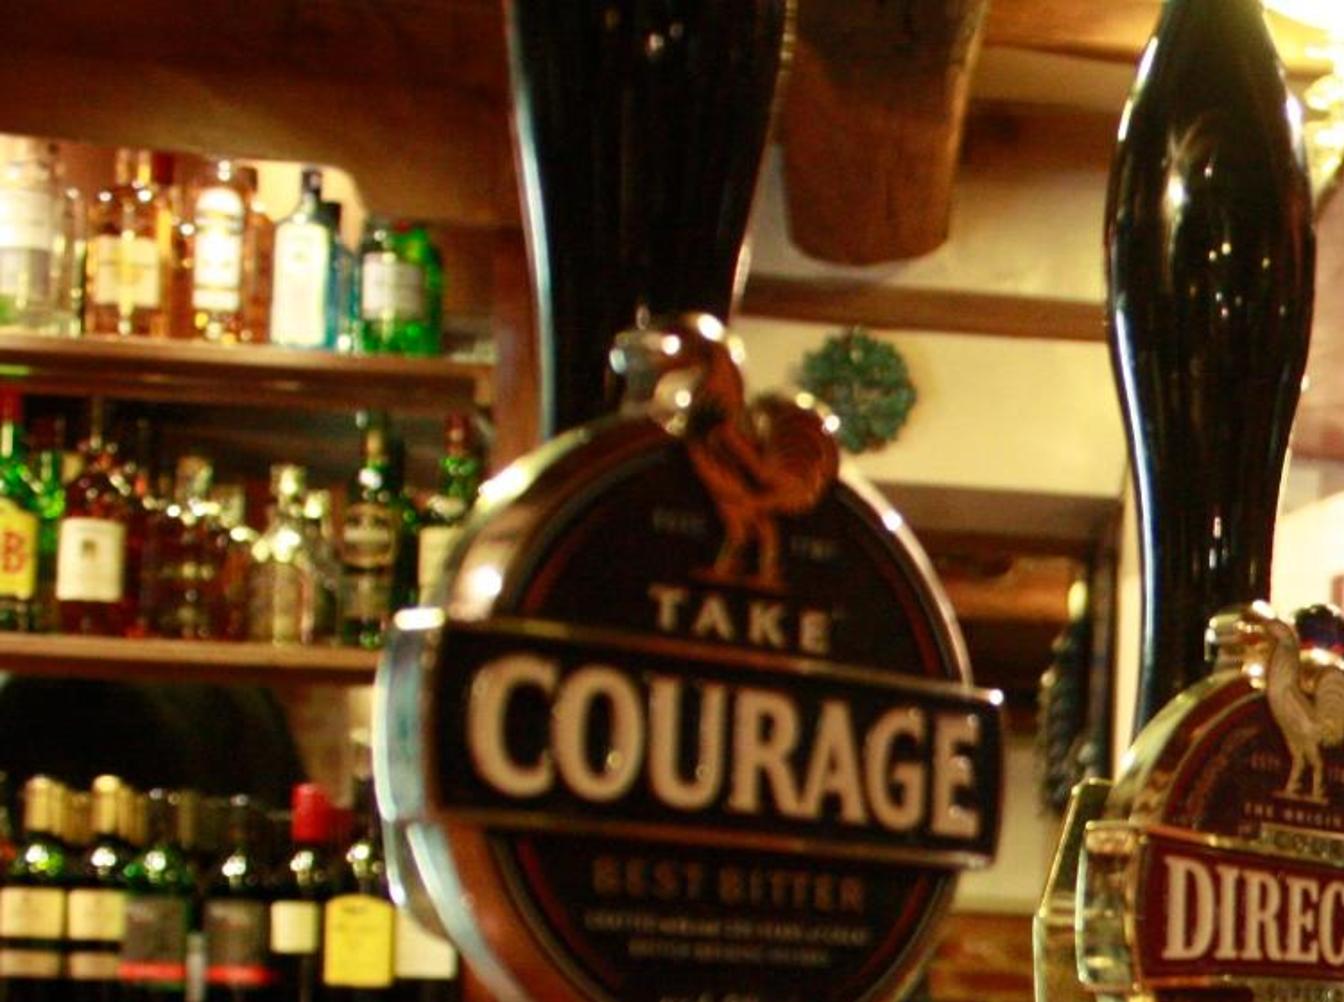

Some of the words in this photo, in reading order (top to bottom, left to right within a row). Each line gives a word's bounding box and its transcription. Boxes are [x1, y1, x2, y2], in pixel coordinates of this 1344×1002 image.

[647, 584, 832, 653] TAKE
[466, 654, 983, 838] COURAGE
[592, 853, 704, 900] BEST
[718, 862, 866, 915] BITTER
